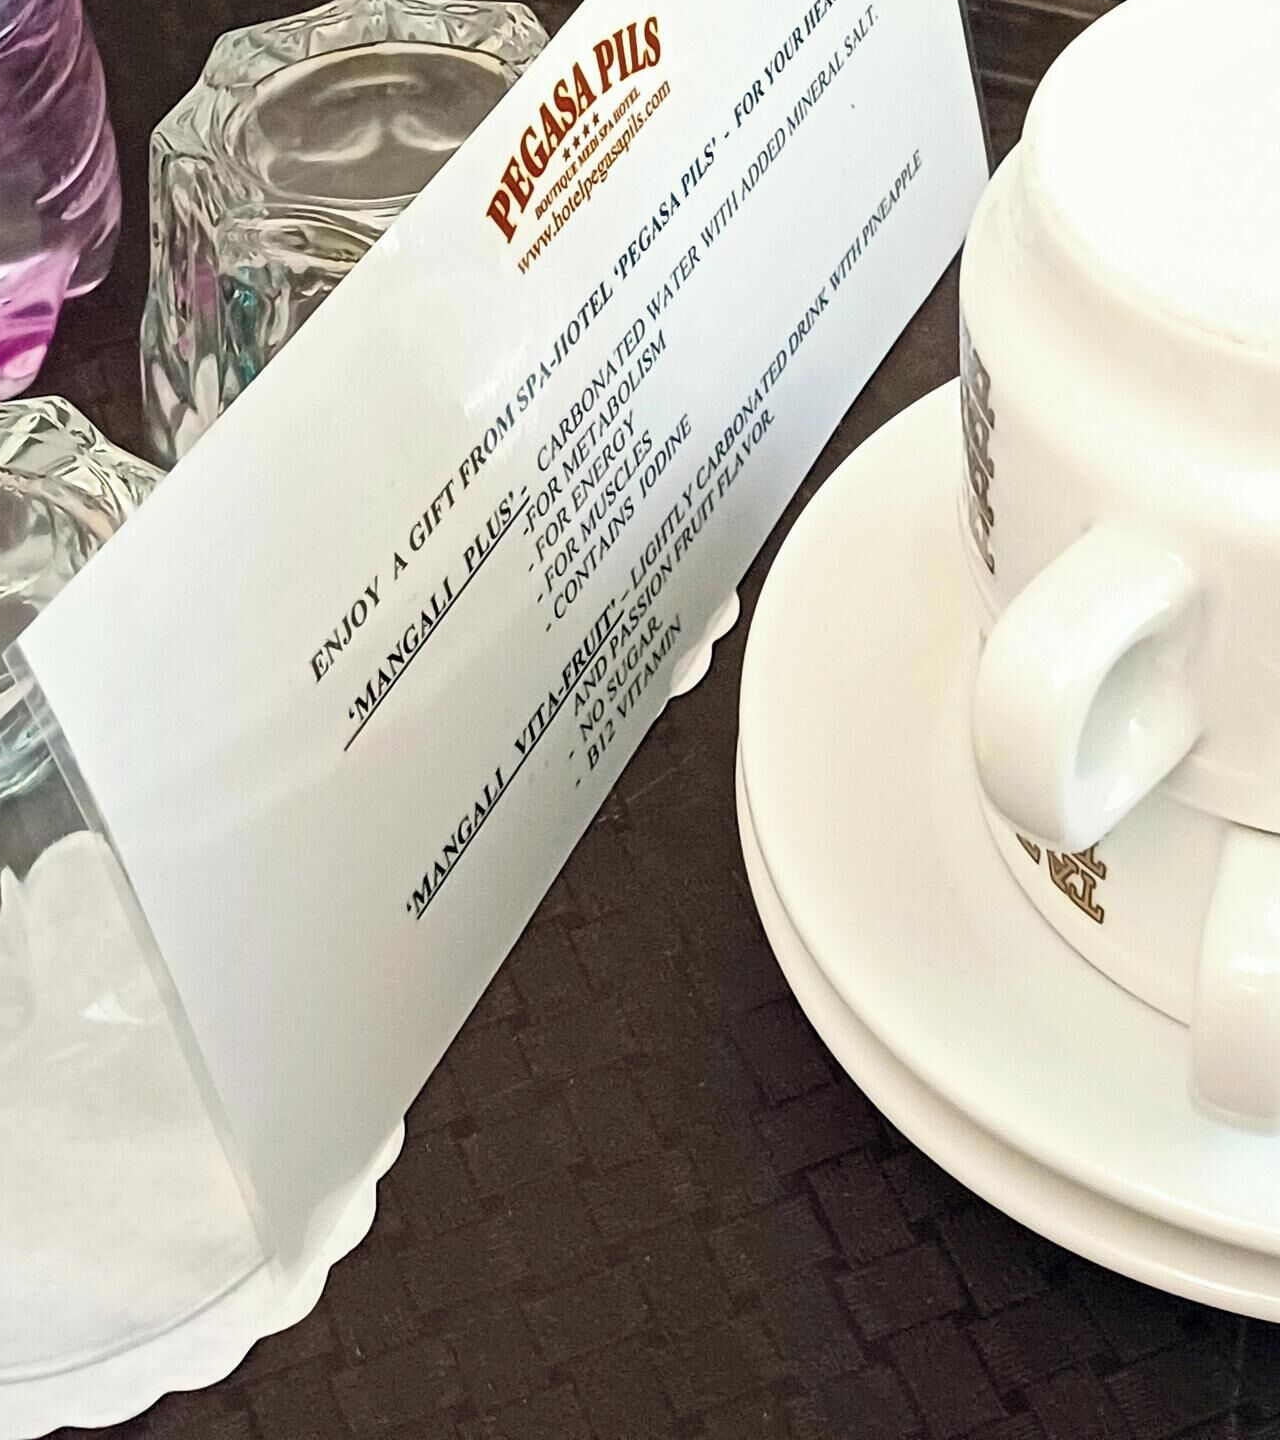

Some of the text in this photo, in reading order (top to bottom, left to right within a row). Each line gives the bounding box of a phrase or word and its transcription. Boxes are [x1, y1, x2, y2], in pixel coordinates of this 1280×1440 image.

[486, 17, 660, 244] PEGASA PILS
[518, 81, 670, 274] www.hotelpegasapils.com
[535, 162, 577, 220] BOUTIQUE
[599, 115, 614, 141] SPA
[613, 88, 640, 124] HOTEL
[538, 319, 645, 471] CARBONATED
[647, 246, 700, 320] WATER
[701, 191, 738, 247] WITH
[742, 128, 785, 200] ADDED
[787, 52, 843, 136] MINERAL
[845, 5, 877, 57] SALT.
[311, 576, 380, 682] ENJOY
[394, 553, 408, 580] A
[410, 479, 454, 551] GIFT
[459, 404, 514, 489] FROM
[517, 282, 613, 412] SPA-HOTEL
[734, 80, 764, 127] FOR
[765, 27, 804, 84] YOUR
[562, 330, 665, 482] METABOLISM
[631, 484, 692, 589] LIGHTLY
[697, 350, 786, 489] CARBONATED
[789, 287, 828, 355] DRINK
[830, 237, 861, 290] WITH
[863, 150, 921, 246] PINEAPPLE
[536, 411, 633, 562] FOR ENERGY
[545, 430, 652, 592] FOR MUSCLES
[554, 414, 691, 619] CONTAINS IODINE
[575, 656, 607, 716] AND
[610, 554, 672, 659] PASSION
[674, 489, 714, 562] FRUIT
[588, 615, 681, 770] B12 VITAMIN
[580, 699, 604, 741] NO
